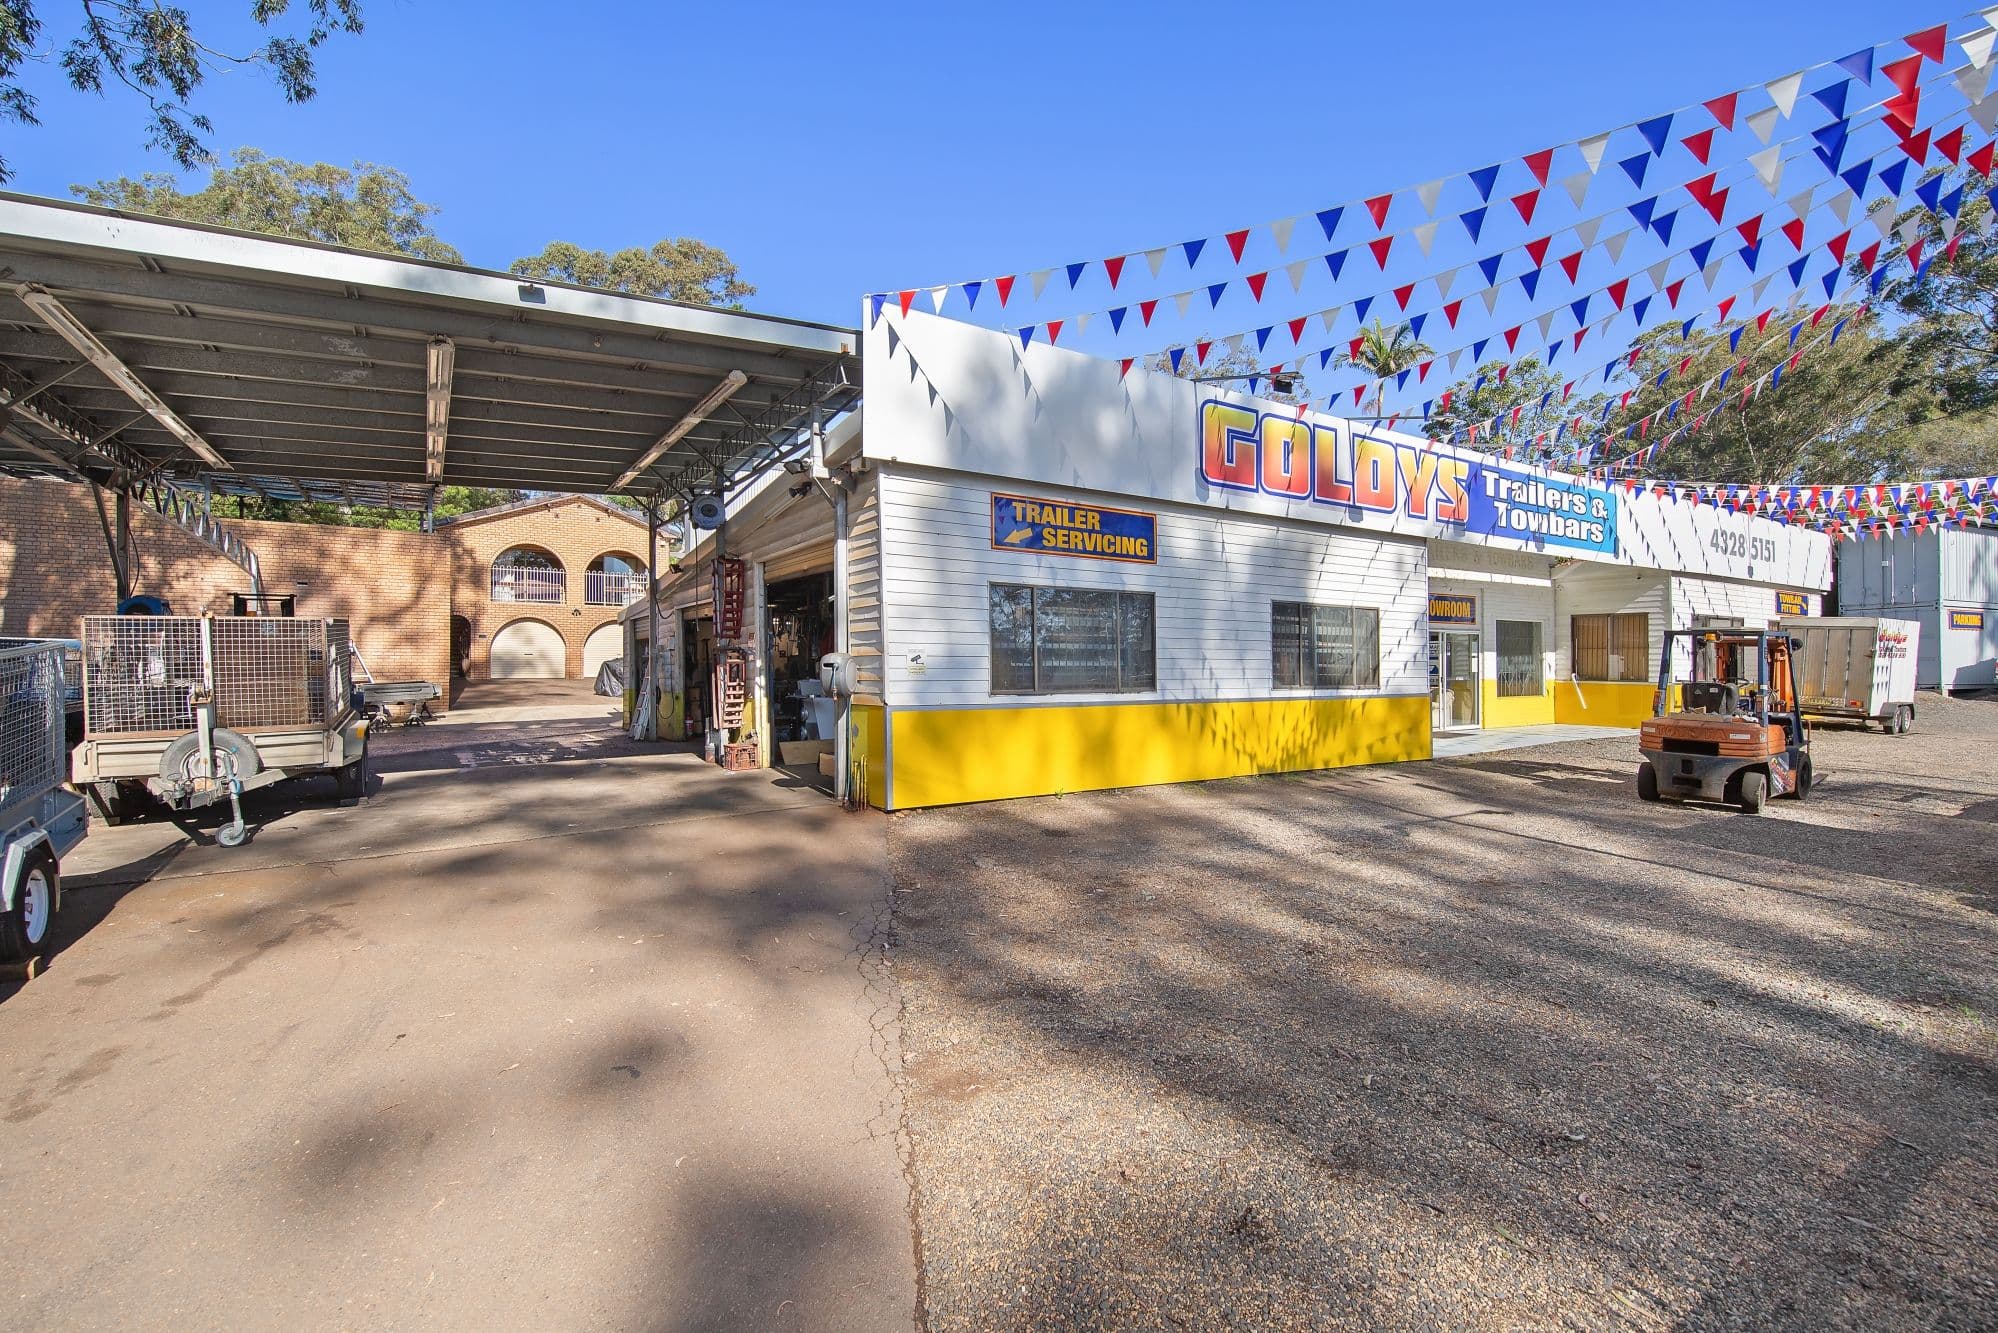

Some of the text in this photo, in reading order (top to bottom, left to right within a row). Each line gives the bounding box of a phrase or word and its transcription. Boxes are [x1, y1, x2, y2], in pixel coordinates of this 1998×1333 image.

[1200, 399, 1469, 524] GOLDYS
[1482, 470, 1608, 519] Trailers &
[1012, 501, 1100, 530] TRAILER
[1493, 501, 1604, 543] Towbars
[1042, 527, 1148, 557] SERVICING
[1710, 529, 1776, 563] 4328 5151
[1430, 600, 1471, 618] OWROOM
[1953, 614, 1982, 626] PARKING
